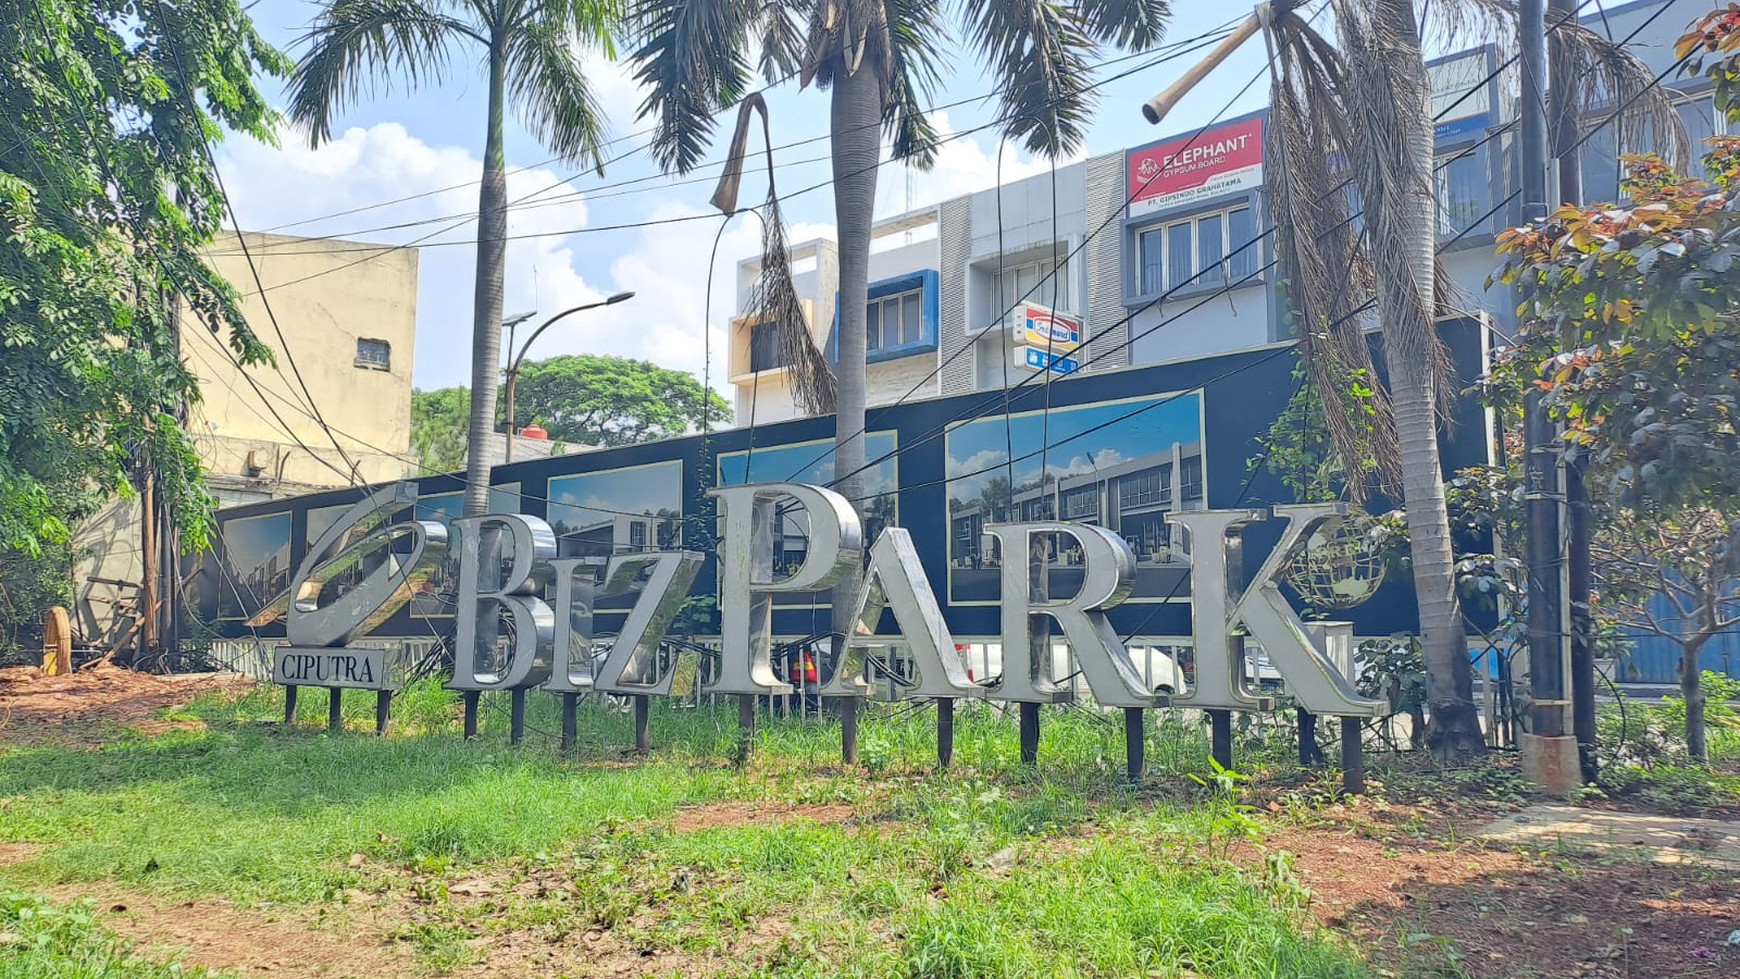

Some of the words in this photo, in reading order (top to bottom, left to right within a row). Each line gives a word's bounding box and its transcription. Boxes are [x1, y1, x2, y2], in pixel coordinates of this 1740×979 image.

[1163, 134, 1248, 169] ELEPHANT
[1163, 163, 1197, 178] GYPSUM
[1197, 156, 1226, 169] BOARD
[1196, 177, 1242, 194] GRAHATAMA
[281, 654, 375, 682] CIPUTRA
